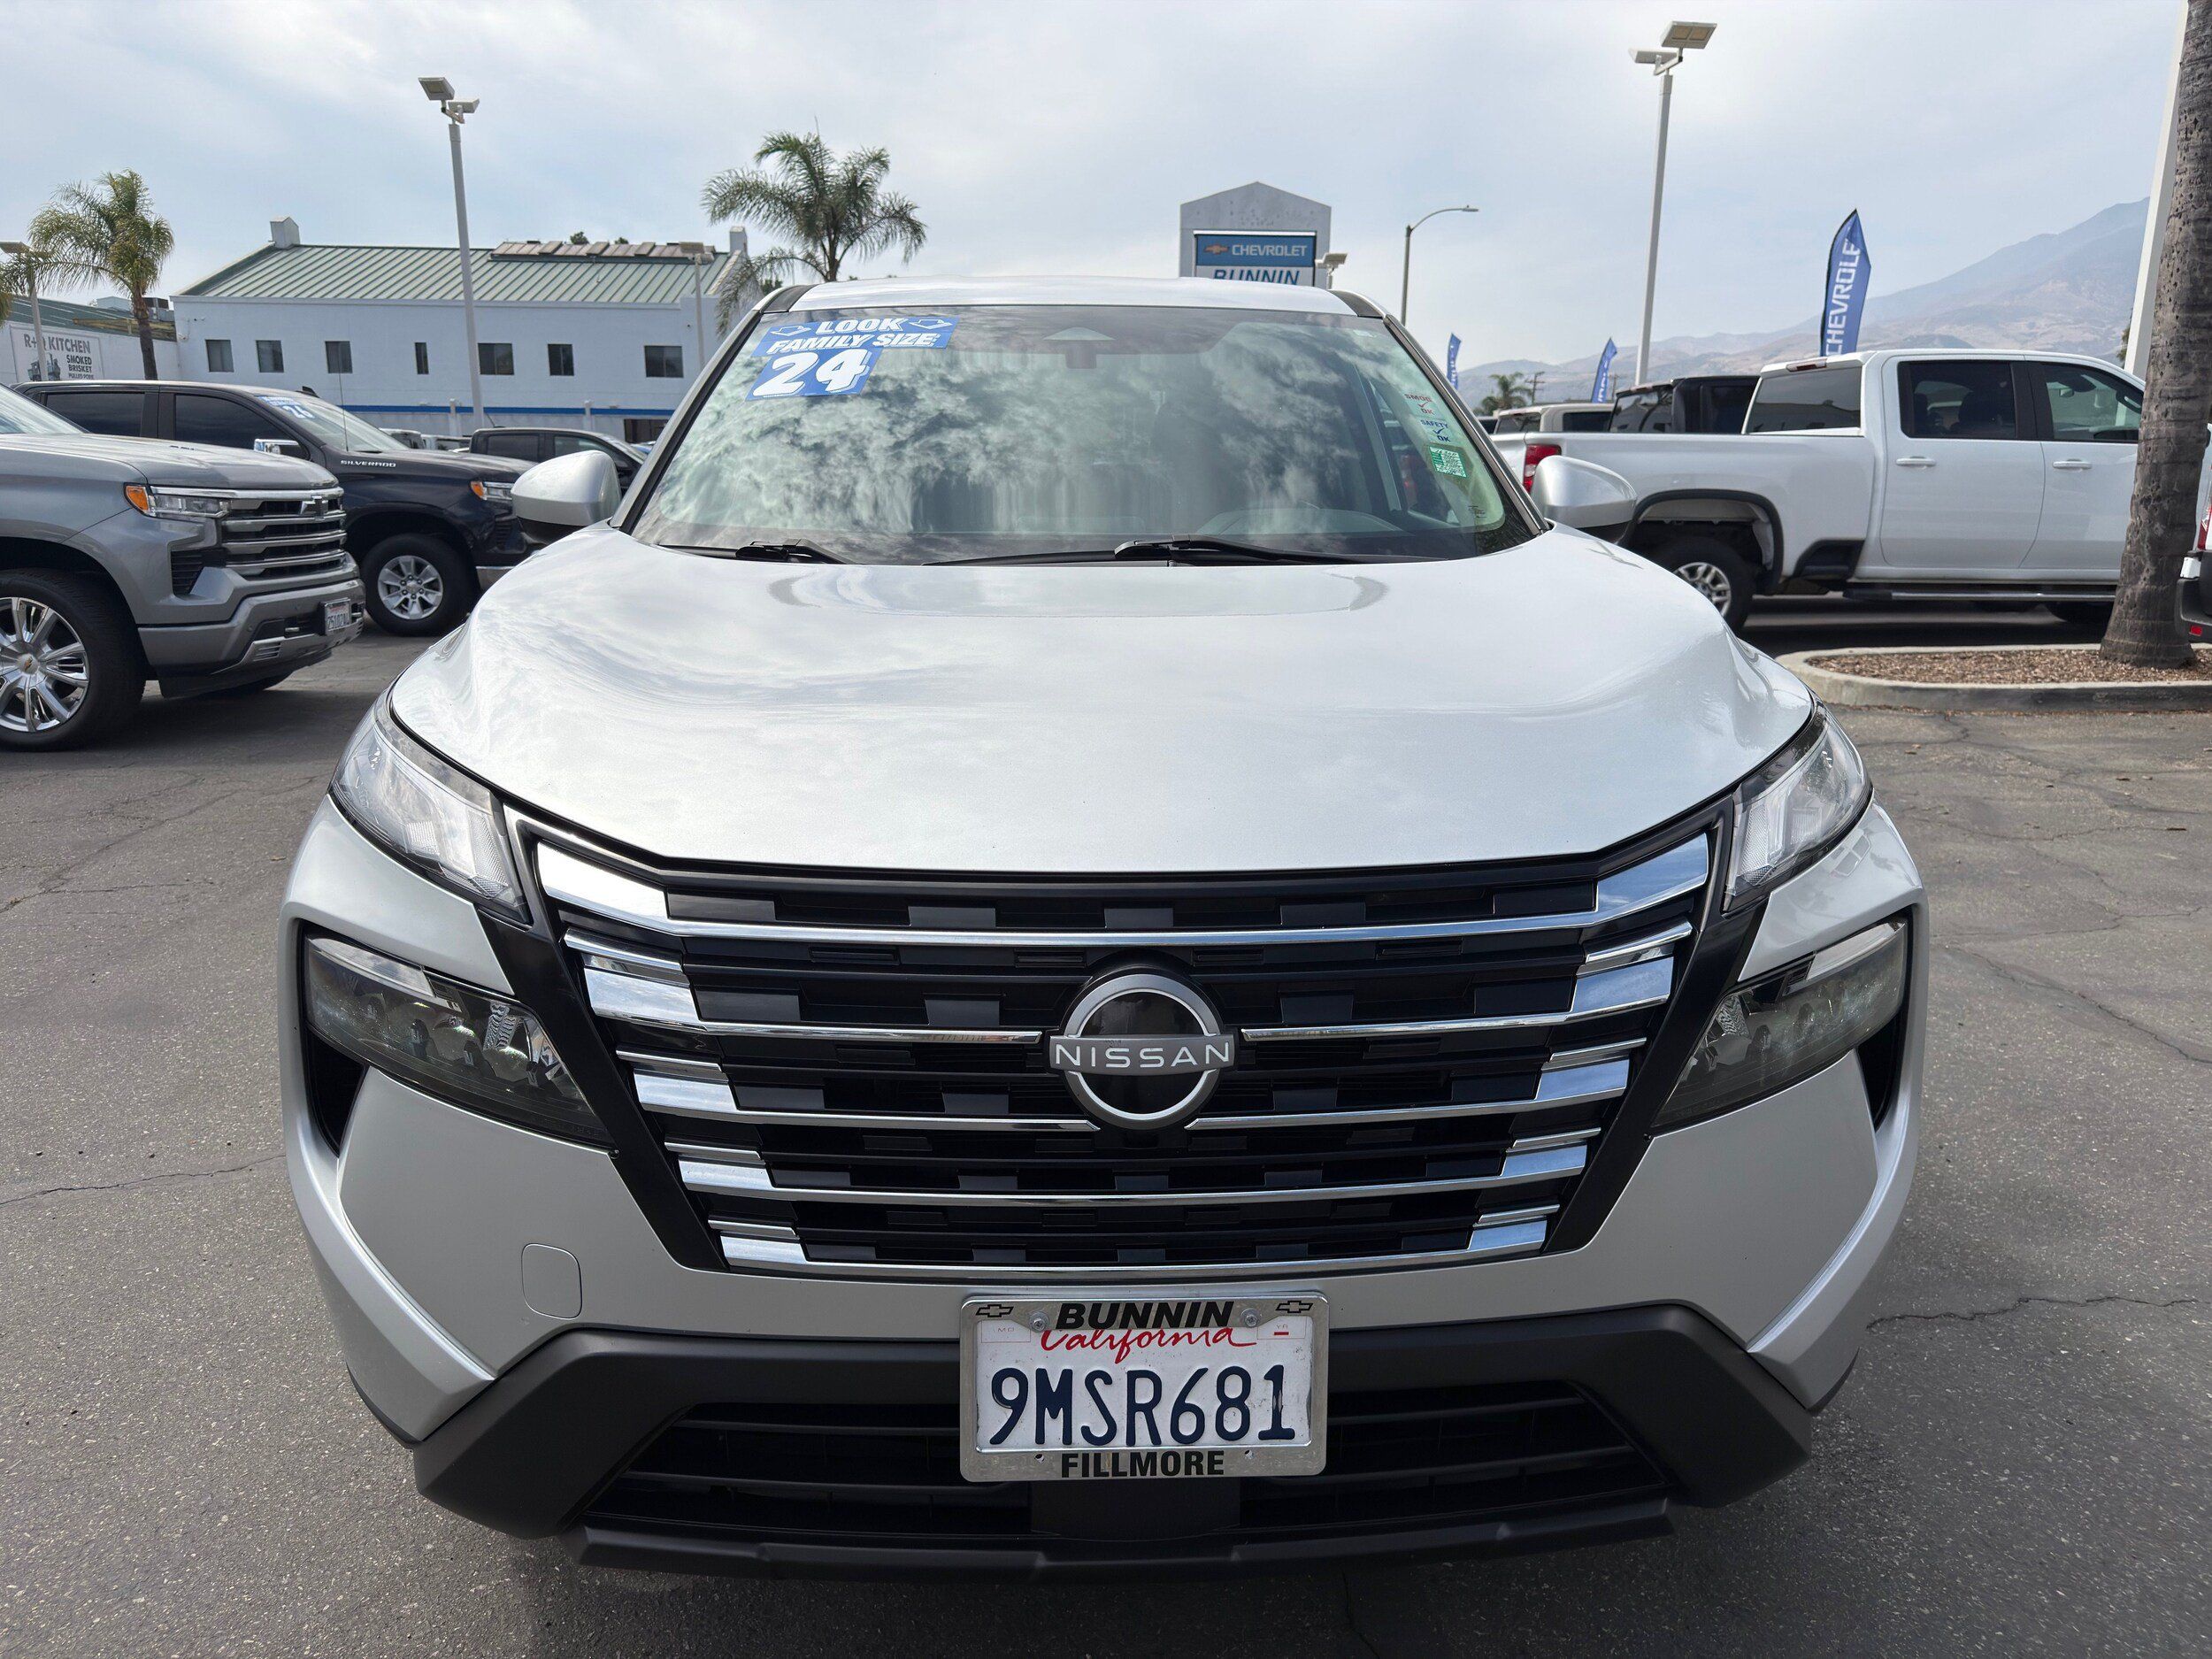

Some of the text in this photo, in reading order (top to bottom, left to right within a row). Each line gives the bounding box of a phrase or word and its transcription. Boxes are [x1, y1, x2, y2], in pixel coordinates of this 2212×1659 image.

[1231, 244, 1308, 257] CHEVROLET
[1213, 269, 1300, 285] BUNNIN
[1825, 227, 1861, 356] CHEVROLE
[815, 318, 909, 334] LOOK
[48, 336, 91, 354] KITCHEN
[766, 332, 941, 354] FAMILY SIZE
[66, 354, 92, 365] SMOKED
[68, 364, 92, 373] BRISKET
[752, 349, 872, 398] 24
[1420, 419, 1448, 428] SAFETY
[1056, 1041, 1229, 1068] NISSAN
[1056, 1302, 1234, 1330] BUNNIN
[1041, 1326, 1256, 1363] California
[989, 1364, 1295, 1447] 9MSR681
[1062, 1451, 1225, 1478] FILLMORE
